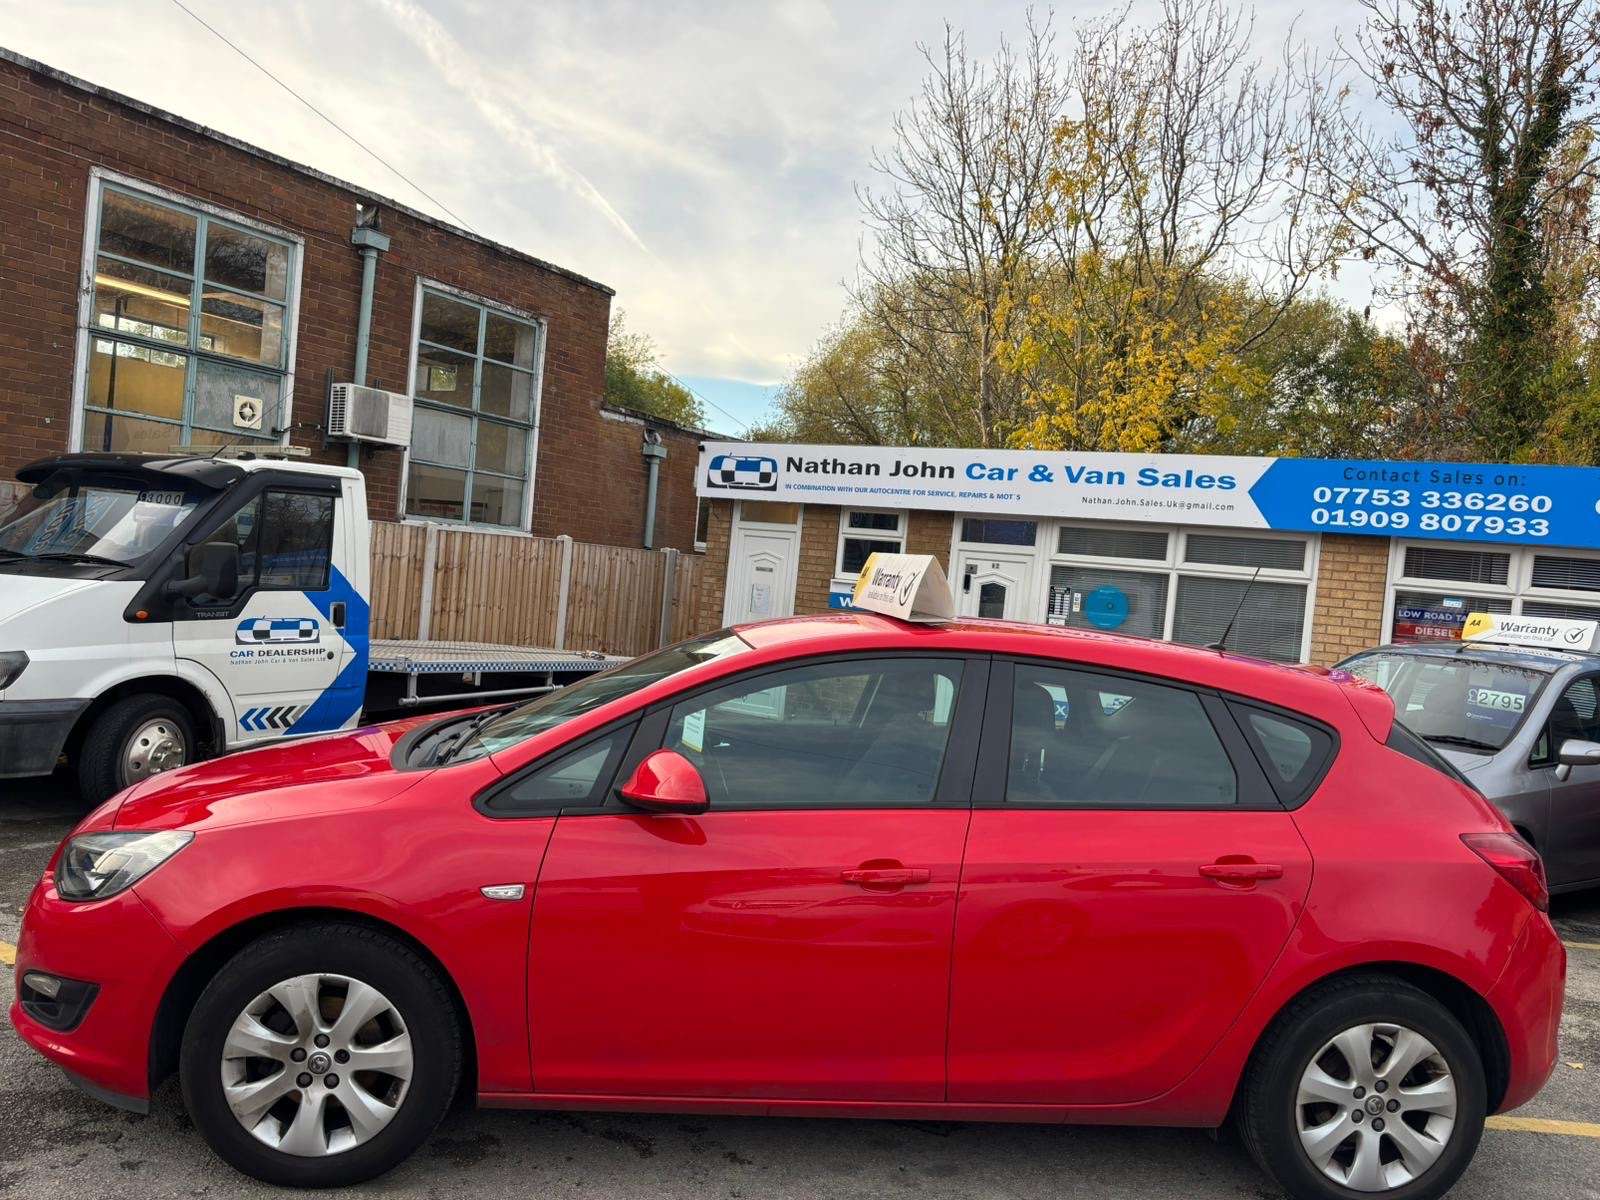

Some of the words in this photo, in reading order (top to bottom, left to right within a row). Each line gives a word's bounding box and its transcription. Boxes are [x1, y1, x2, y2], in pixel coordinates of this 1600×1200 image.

[786, 456, 881, 476] Nathan
[889, 460, 954, 479] John
[965, 463, 1018, 481] Car
[1028, 464, 1054, 483] &
[1064, 465, 1126, 486] Van
[1137, 467, 1236, 490] Sales
[1343, 467, 1420, 484] Contact
[1430, 470, 1484, 485] Sales
[1494, 475, 1526, 487] on:
[793, 484, 836, 492] COMBINATION
[837, 486, 853, 494] WITH
[869, 487, 911, 496] AUTOCENTRE
[959, 491, 987, 499] REPAIRS
[1082, 496, 1235, 511] Nathan.John.Sales.Uk@gmail.com
[1313, 486, 1411, 507] 07753
[1420, 491, 1552, 513] 336260
[1311, 508, 1410, 528] 01909
[1419, 514, 1550, 536] 807933
[871, 567, 903, 593] Warranty
[1398, 609, 1421, 618] LOW
[1423, 612, 1453, 621] ROAD
[1469, 619, 1481, 627] AA
[1500, 621, 1559, 637] Warranty
[1415, 626, 1455, 638] DIESEL
[230, 650, 254, 659] CAR
[258, 648, 326, 657] DEALERSHIP
